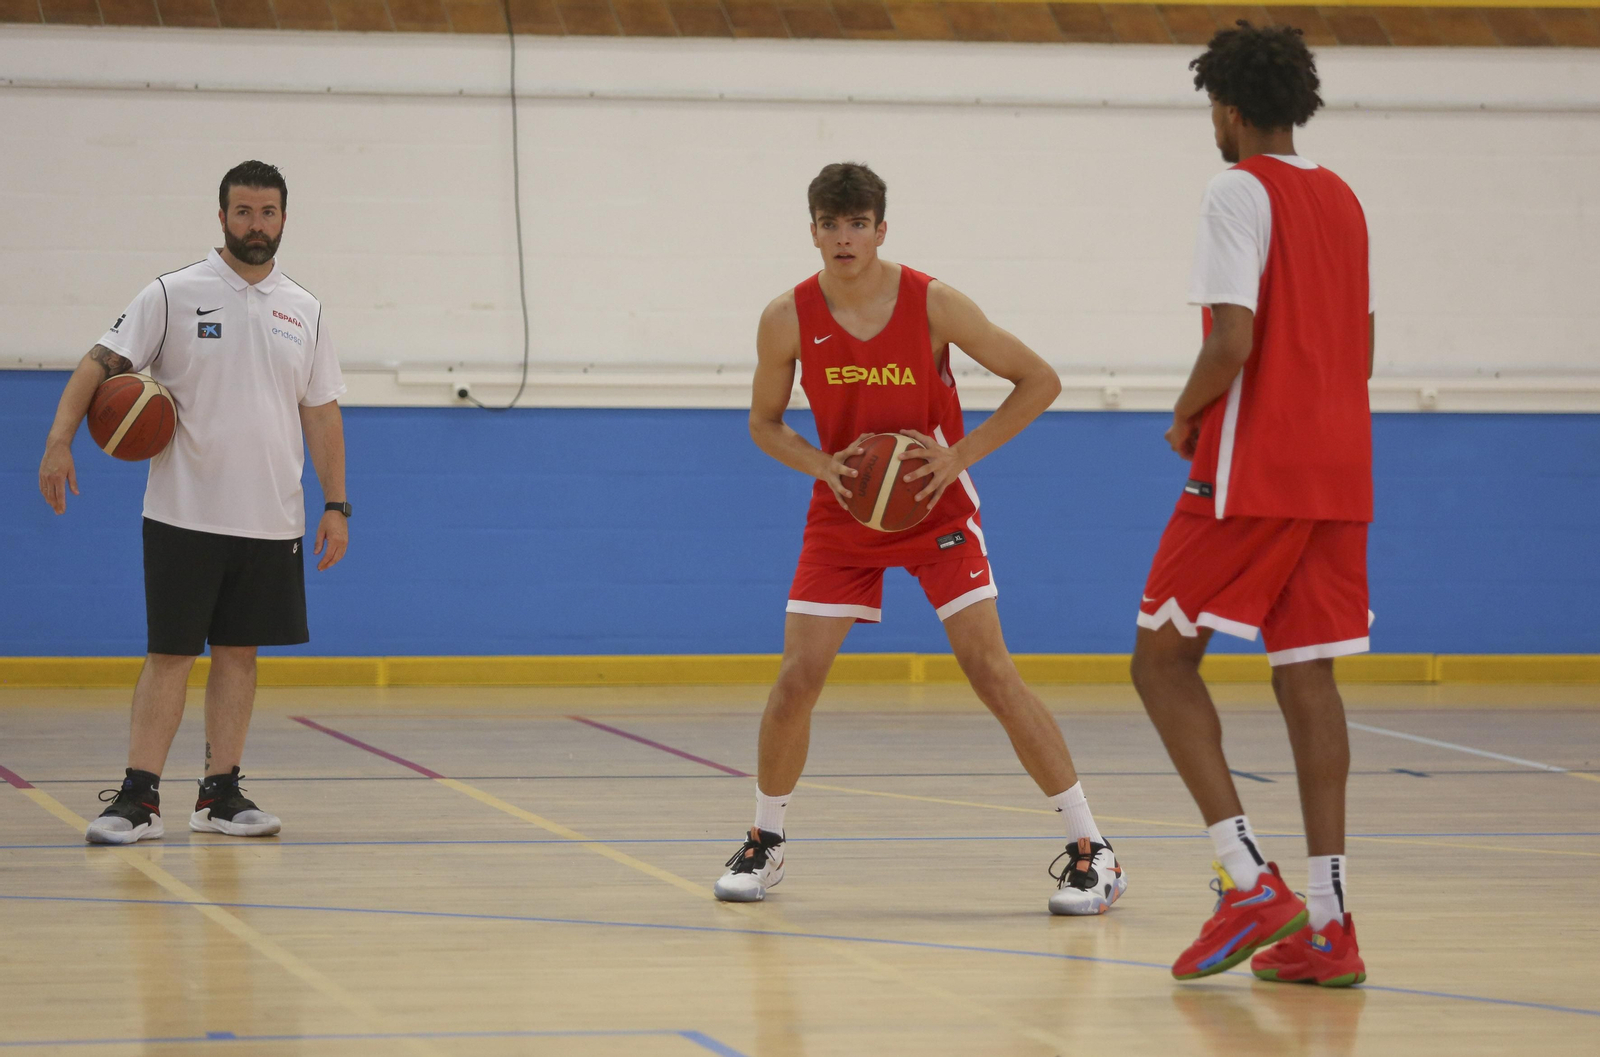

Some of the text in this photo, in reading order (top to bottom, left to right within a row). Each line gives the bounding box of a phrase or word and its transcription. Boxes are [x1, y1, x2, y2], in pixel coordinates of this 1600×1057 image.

[272, 310, 302, 328] ESPAÑA
[271, 327, 302, 346] endesa
[825, 363, 916, 386] ESPAÑA
[859, 454, 879, 497] molten
[954, 534, 963, 542] XL
